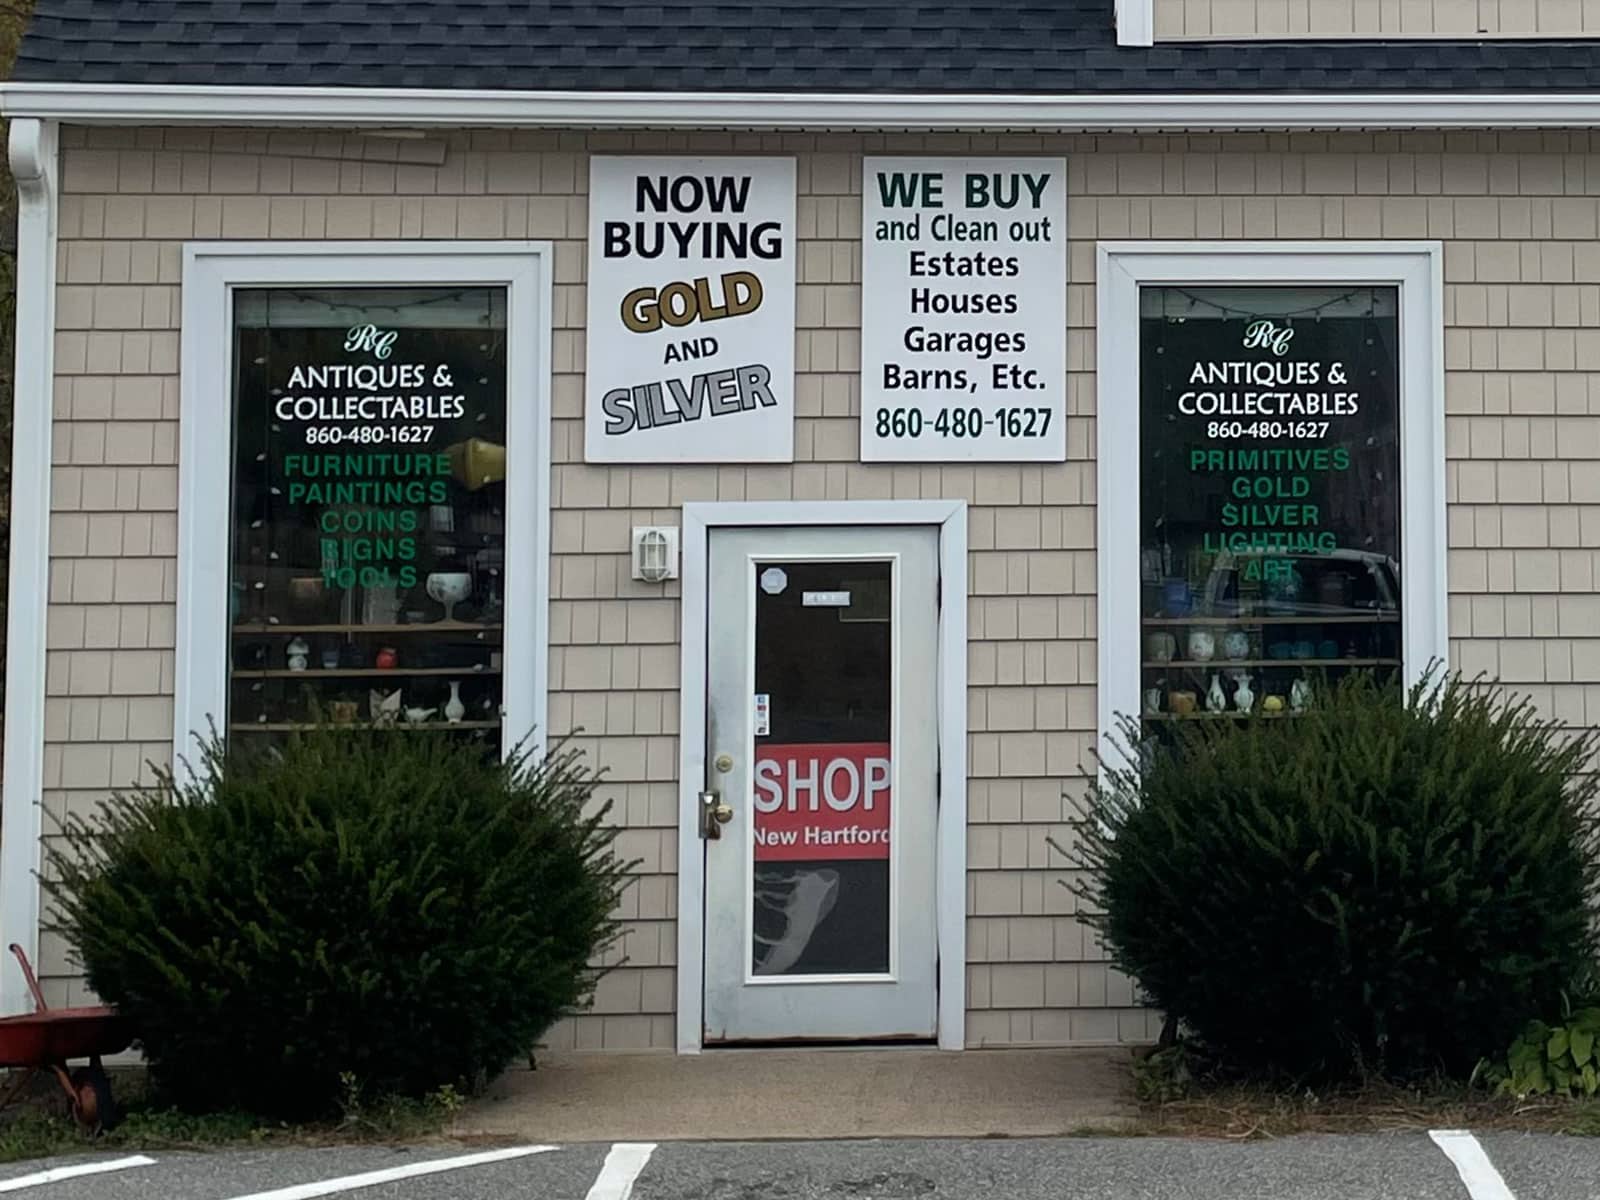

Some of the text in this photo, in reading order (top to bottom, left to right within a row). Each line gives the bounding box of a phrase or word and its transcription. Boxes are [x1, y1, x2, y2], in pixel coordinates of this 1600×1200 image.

[635, 175, 751, 214] NOW
[877, 172, 1050, 209] WE BUY
[603, 221, 782, 260] BUYING
[876, 214, 1051, 242] and Clean out
[910, 251, 1019, 276] Estates
[620, 271, 763, 333] GOLD
[911, 288, 1017, 314] Houses
[344, 324, 398, 359] RC
[663, 336, 719, 365] AND
[904, 326, 1026, 359] Garages
[1243, 320, 1294, 356] RC
[288, 364, 453, 391] ANTIQUES &
[883, 364, 1046, 393] Barns, Etc.
[1190, 361, 1347, 387] ANTIQUES &
[275, 396, 465, 420] COLLECTABLES
[601, 364, 777, 435] SILVER
[1178, 392, 1359, 415] COLLECTABLES
[306, 426, 434, 445] 860-480-1627
[876, 408, 1052, 438] 860-480-1627
[1207, 422, 1329, 438] 860-480-1627
[284, 454, 452, 477] FURNITURE
[1190, 448, 1350, 471] PRIMITIVES
[289, 481, 447, 504] PAINTINGS
[1232, 476, 1310, 498] GOLD
[321, 510, 417, 533] COINS
[1221, 503, 1319, 526] SILVER
[1203, 532, 1336, 553] LIGHTING
[1243, 559, 1297, 581] ART
[754, 757, 890, 812] SHOP
[753, 828, 797, 846] New
